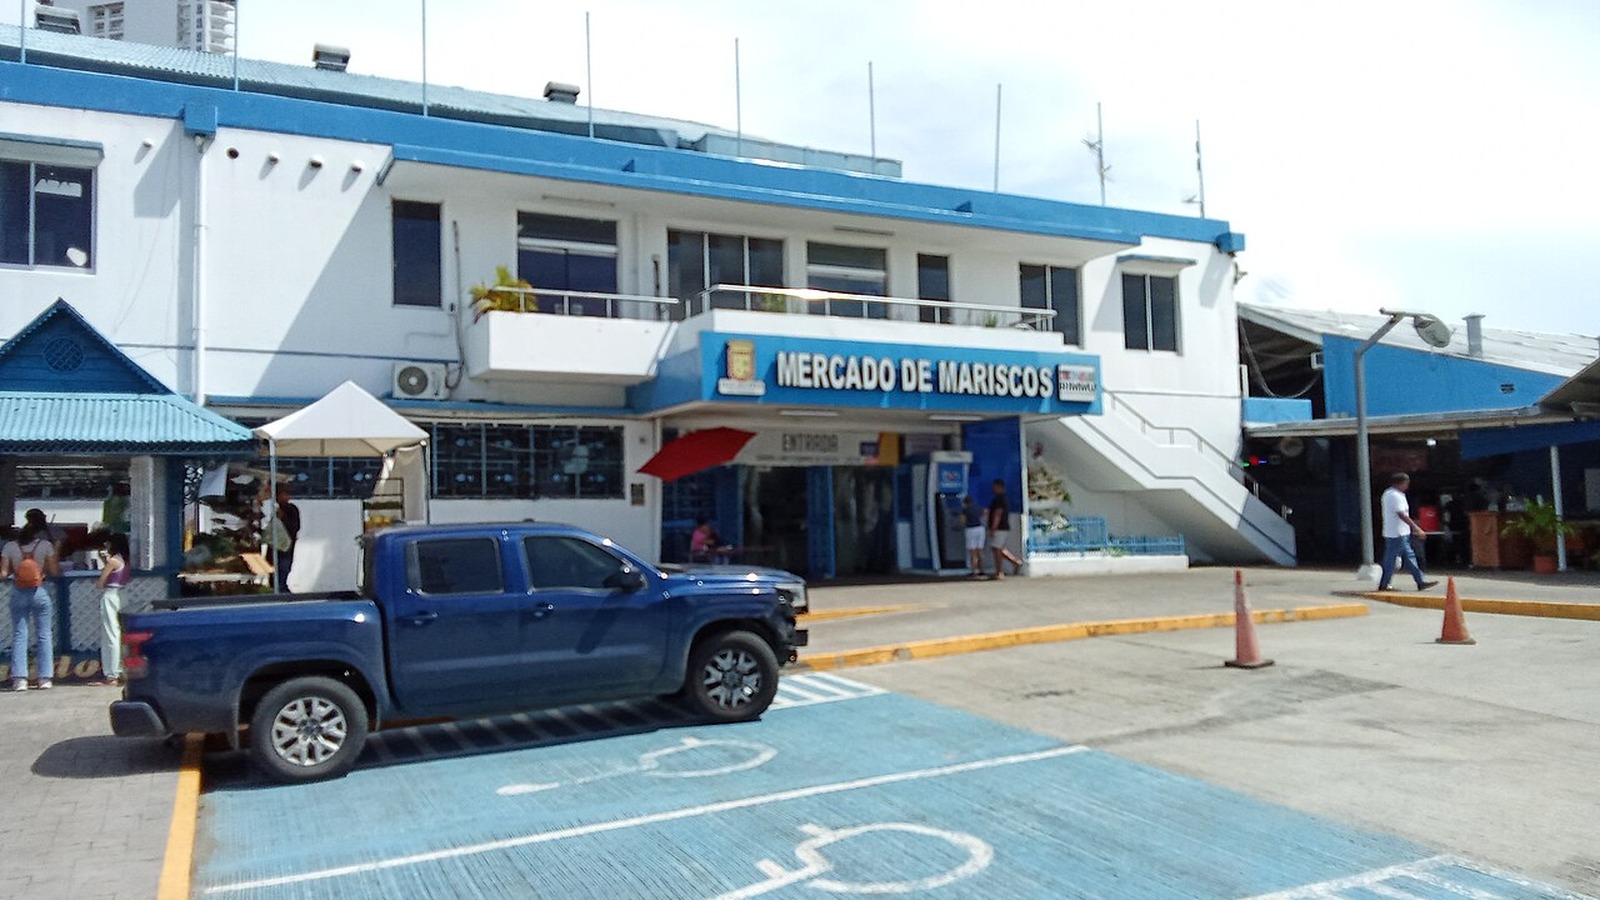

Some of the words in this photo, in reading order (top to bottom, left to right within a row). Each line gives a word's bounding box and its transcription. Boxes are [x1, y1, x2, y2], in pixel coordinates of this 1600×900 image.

[776, 351, 896, 392] MERCADO
[900, 358, 933, 392] DE
[938, 360, 1054, 398] MARISCOS
